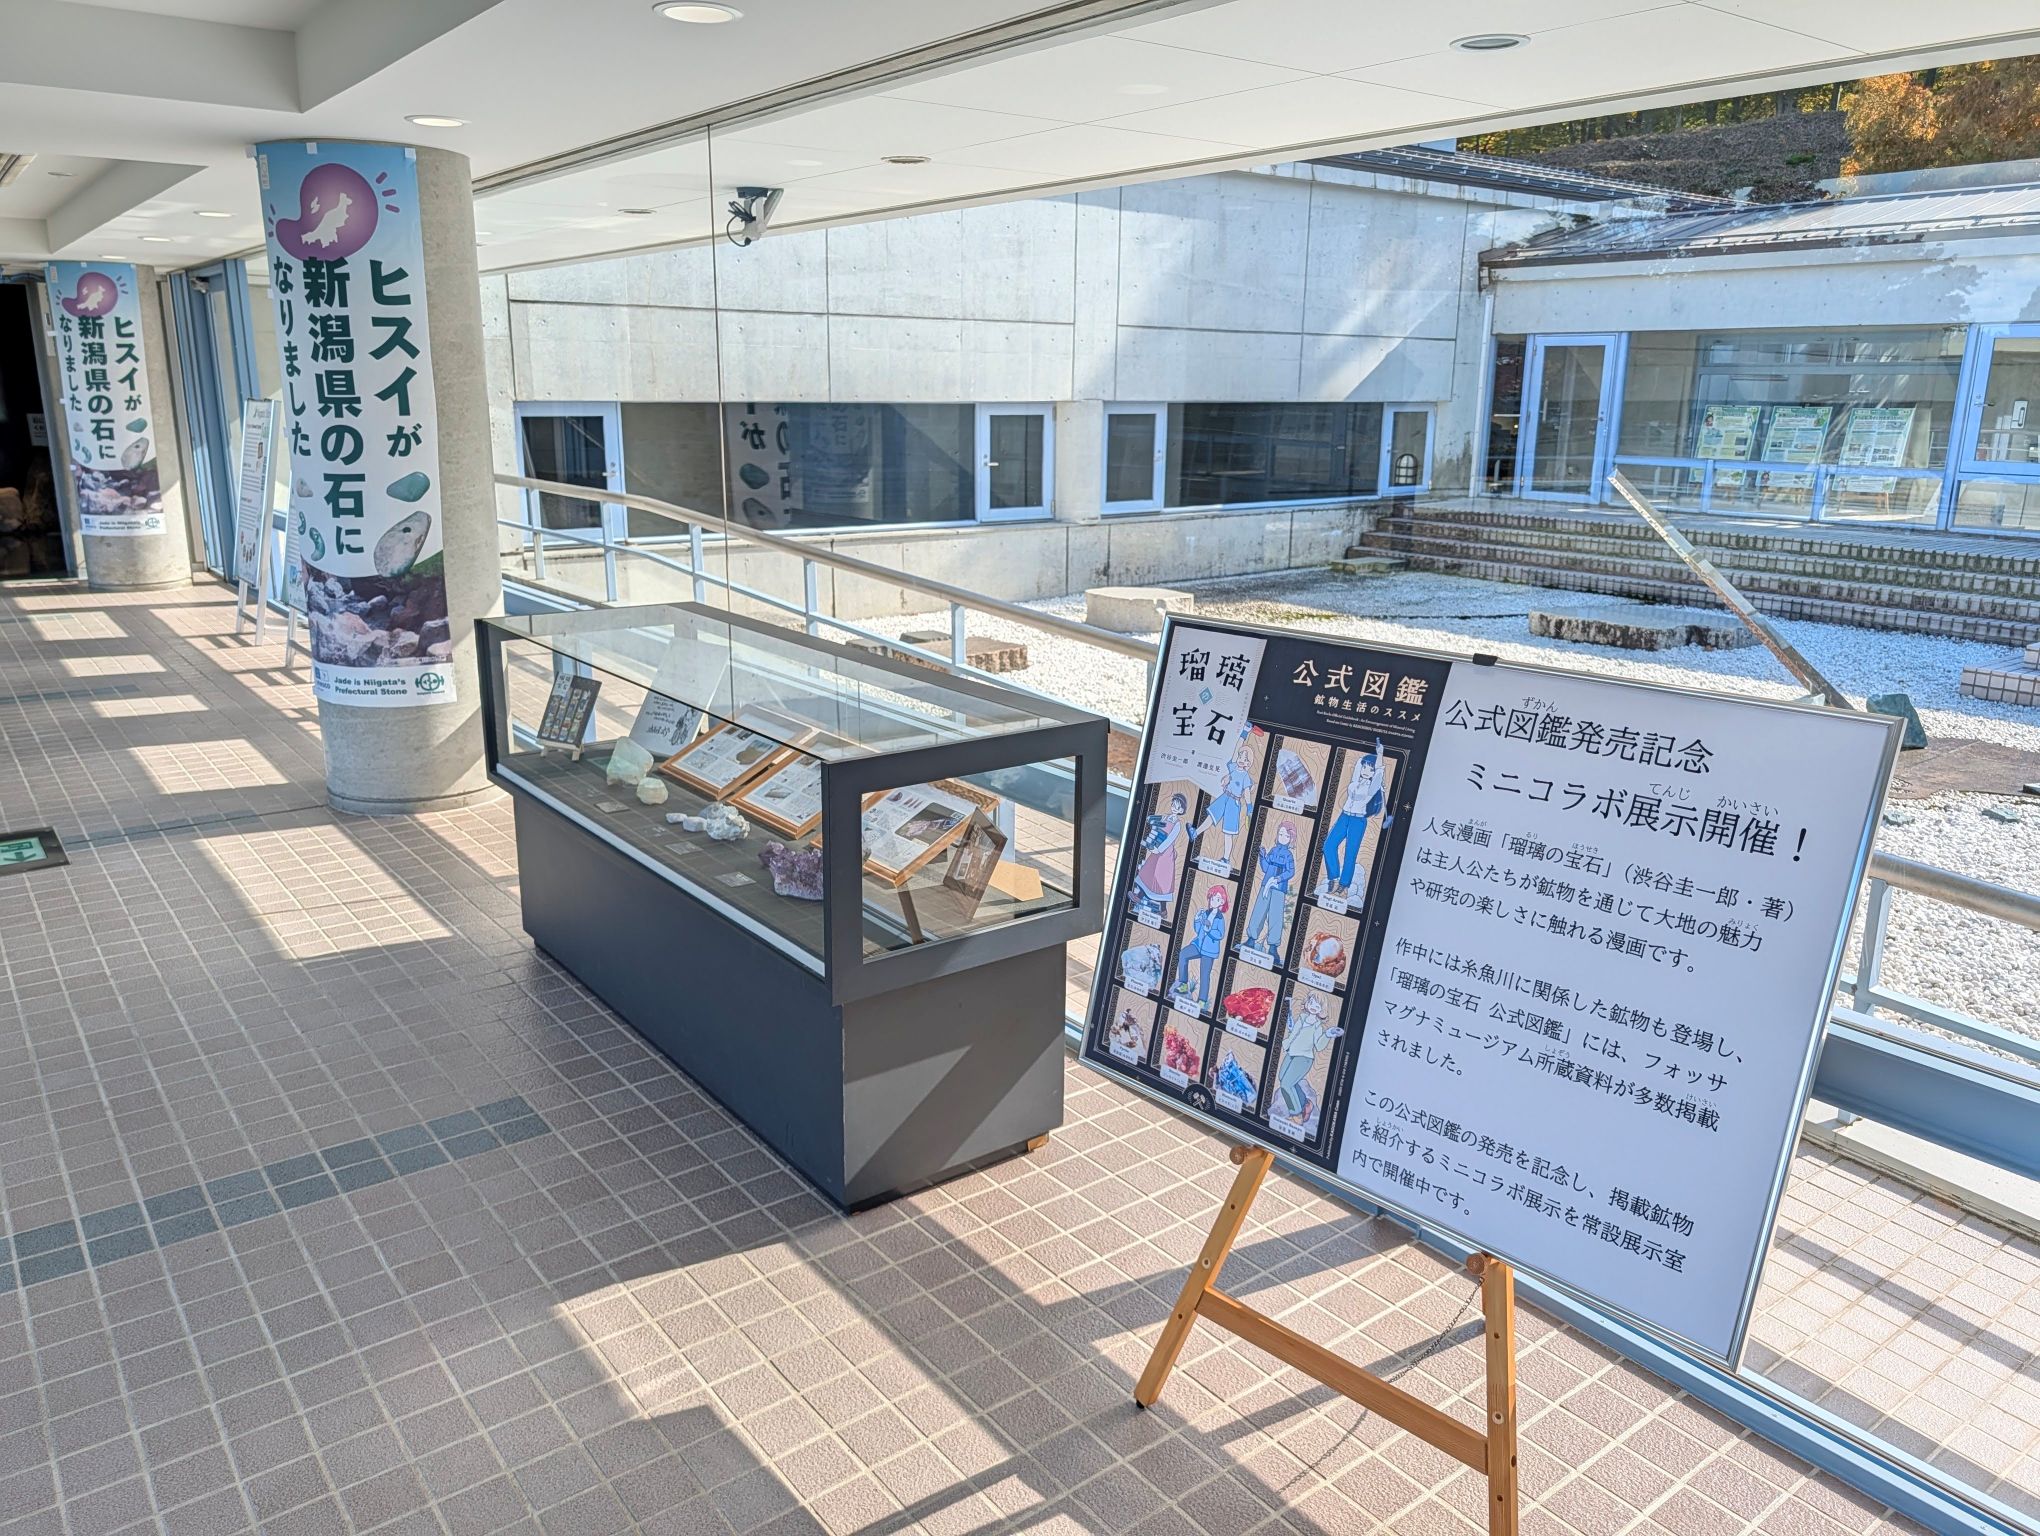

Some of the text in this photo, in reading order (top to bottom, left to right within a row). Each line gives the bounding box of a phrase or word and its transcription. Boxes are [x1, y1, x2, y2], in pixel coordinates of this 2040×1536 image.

[59, 314, 83, 412] なりました
[79, 315, 117, 460] 新潟県の石に
[113, 316, 142, 411] ヒスイが
[273, 256, 311, 457] なりました
[368, 260, 423, 459] ヒスイが
[303, 256, 366, 556] 新潟県の石に
[334, 676, 351, 685] Jade
[354, 677, 360, 685] is
[335, 686, 377, 695] Prefectural
[1179, 648, 1251, 692] 瑠璃
[1292, 659, 1429, 706] 公式図鑑
[1313, 693, 1421, 722] 鉱物生活のススメ
[1522, 696, 1558, 713] ずかん
[1173, 702, 1234, 746] 宝石
[1445, 699, 1715, 775] 公式図鑑発売記念
[1465, 762, 1810, 863] ミニコラボ展示開催！
[1649, 782, 1691, 801] てんじ
[1717, 794, 1779, 817] かいさい
[1410, 878, 1698, 974] や研究の楽しさに触れる漫画です。
[1416, 846, 1763, 952] は主人公たちが鉱物を通じて大地の魅力
[1395, 937, 1744, 1064] 作中には糸魚川に関係した鉱物も登場し、
[1376, 1028, 1464, 1077] されました。
[1383, 999, 1720, 1132] マグナミュージアム所蔵資料が多数掲載
[1351, 1148, 1473, 1216] 内で開催中です。
[1358, 1118, 1687, 1275] を紹介するミニコラボ展示を常設展示室
